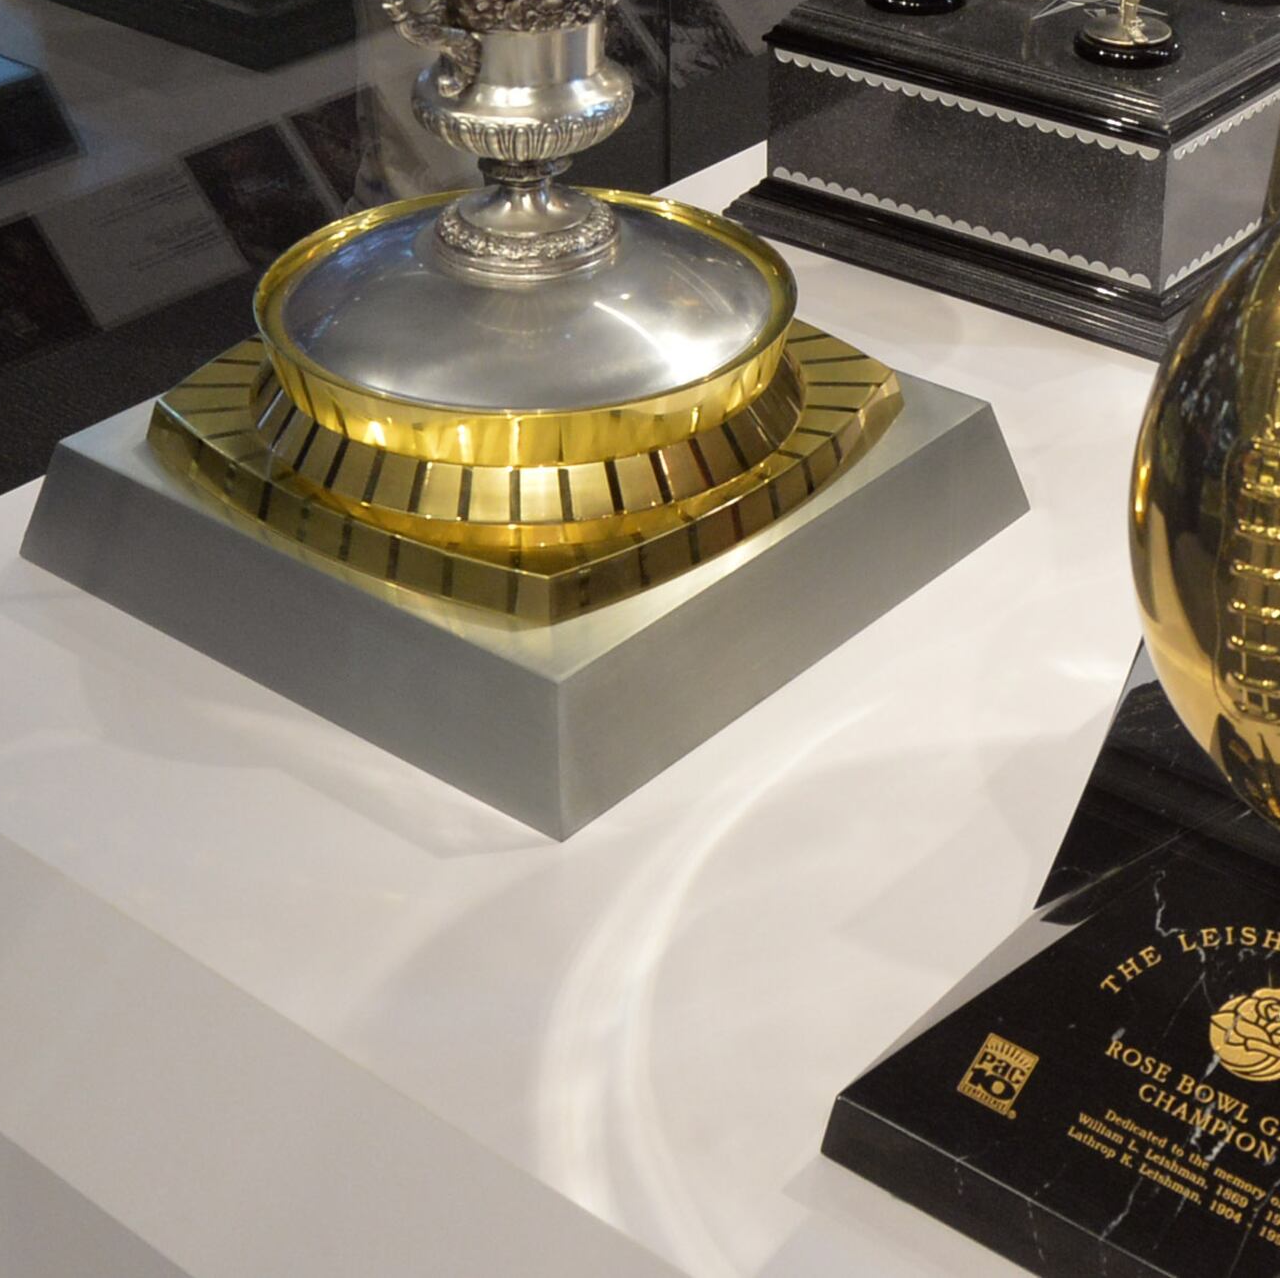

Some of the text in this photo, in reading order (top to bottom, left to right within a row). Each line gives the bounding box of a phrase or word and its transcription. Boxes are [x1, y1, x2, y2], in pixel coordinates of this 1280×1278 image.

[1100, 946, 1162, 994] THE
[1105, 1040, 1172, 1083] ROSE
[1176, 1074, 1249, 1124] BOWL
[1138, 1083, 1277, 1163] CHAMPION
[1067, 1125, 1117, 1159] Lathrop
[1120, 1153, 1133, 1169] K.
[1209, 1199, 1243, 1224] 1904
[1078, 1112, 1124, 1145] William
[1127, 1138, 1139, 1153] L.
[1215, 1184, 1249, 1209] 1869
[1105, 1109, 1168, 1149] Dedicated
[1172, 1140, 1185, 1158] to
[1188, 1150, 1210, 1171] the
[1214, 1165, 1266, 1201] memory
